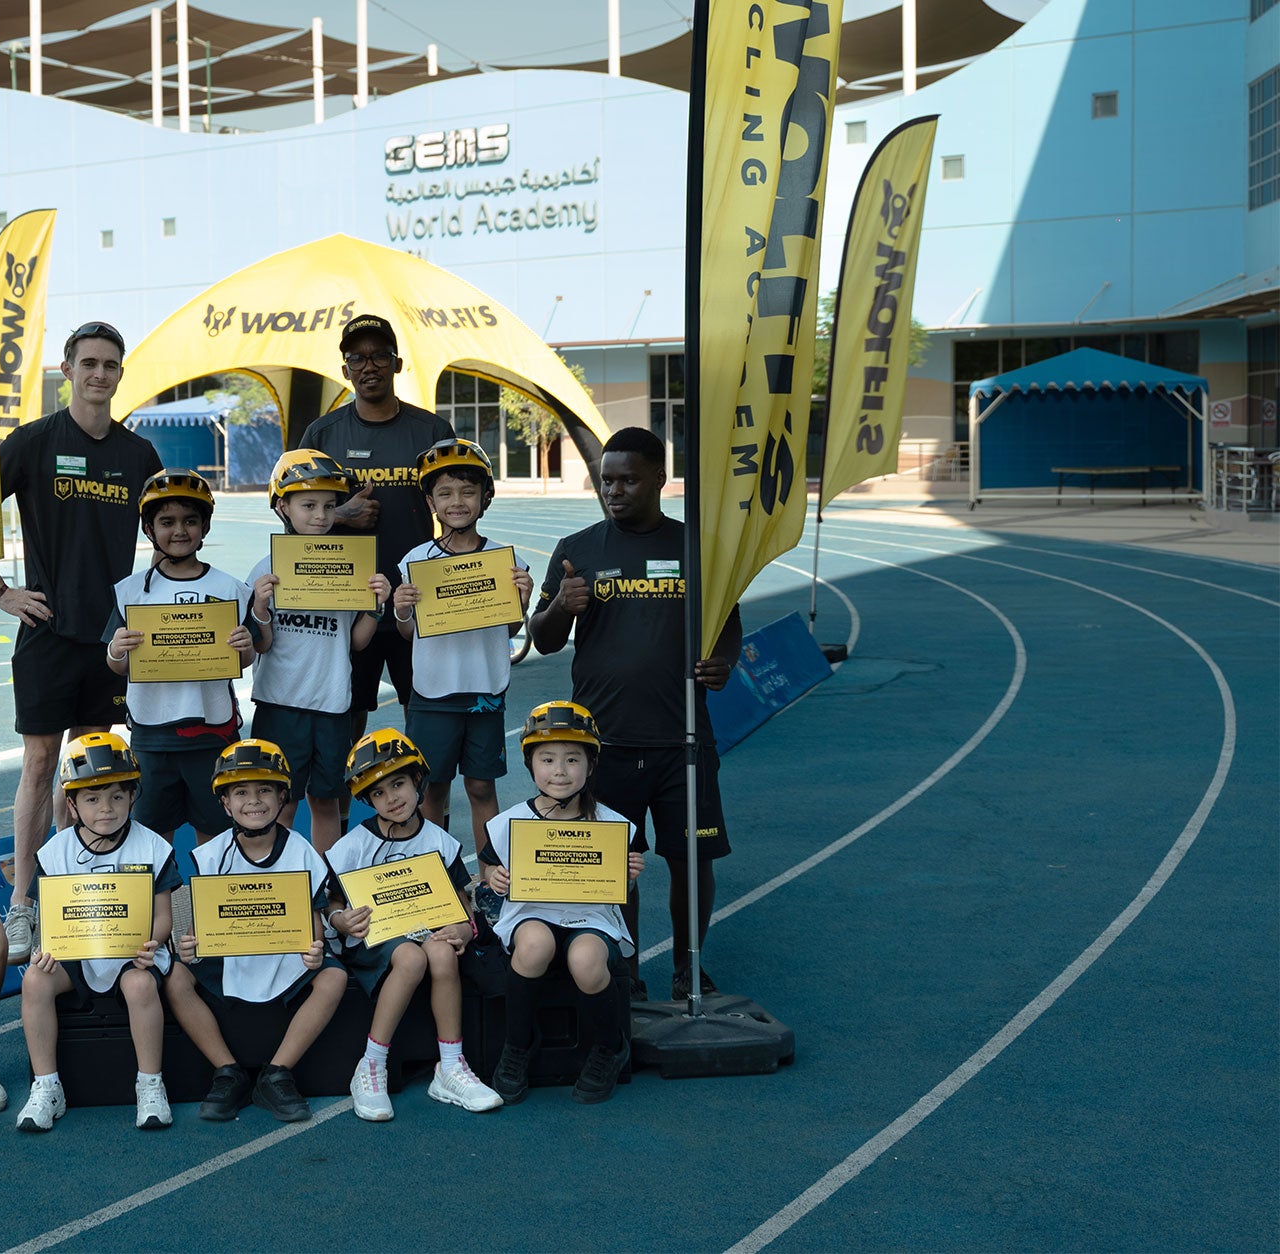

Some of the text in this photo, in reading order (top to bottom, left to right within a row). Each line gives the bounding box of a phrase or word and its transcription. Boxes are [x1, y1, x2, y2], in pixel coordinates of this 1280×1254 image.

[385, 123, 510, 175] GEMS
[385, 157, 601, 206] أكاديمية جيمس العالمية
[386, 197, 600, 241] World Academy
[241, 301, 356, 334] WOLFI'S
[354, 467, 418, 482] WOLFI'S
[74, 479, 128, 500] WOLFI'S
[453, 561, 483, 571] WOLFI'S
[438, 584, 494, 598] BRILLIANT BALANCE
[440, 581, 482, 592] INTRODUCTION
[616, 579, 685, 593] WOLFI'S
[277, 613, 338, 632] WOLFI'S
[307, 630, 338, 638] ACADEMY
[383, 867, 413, 879] WOLFI'S
[83, 883, 116, 891] WOLFI'S
[376, 886, 418, 900] INTRODUCTION
[376, 888, 431, 905] BRILLIANT BALANCE
